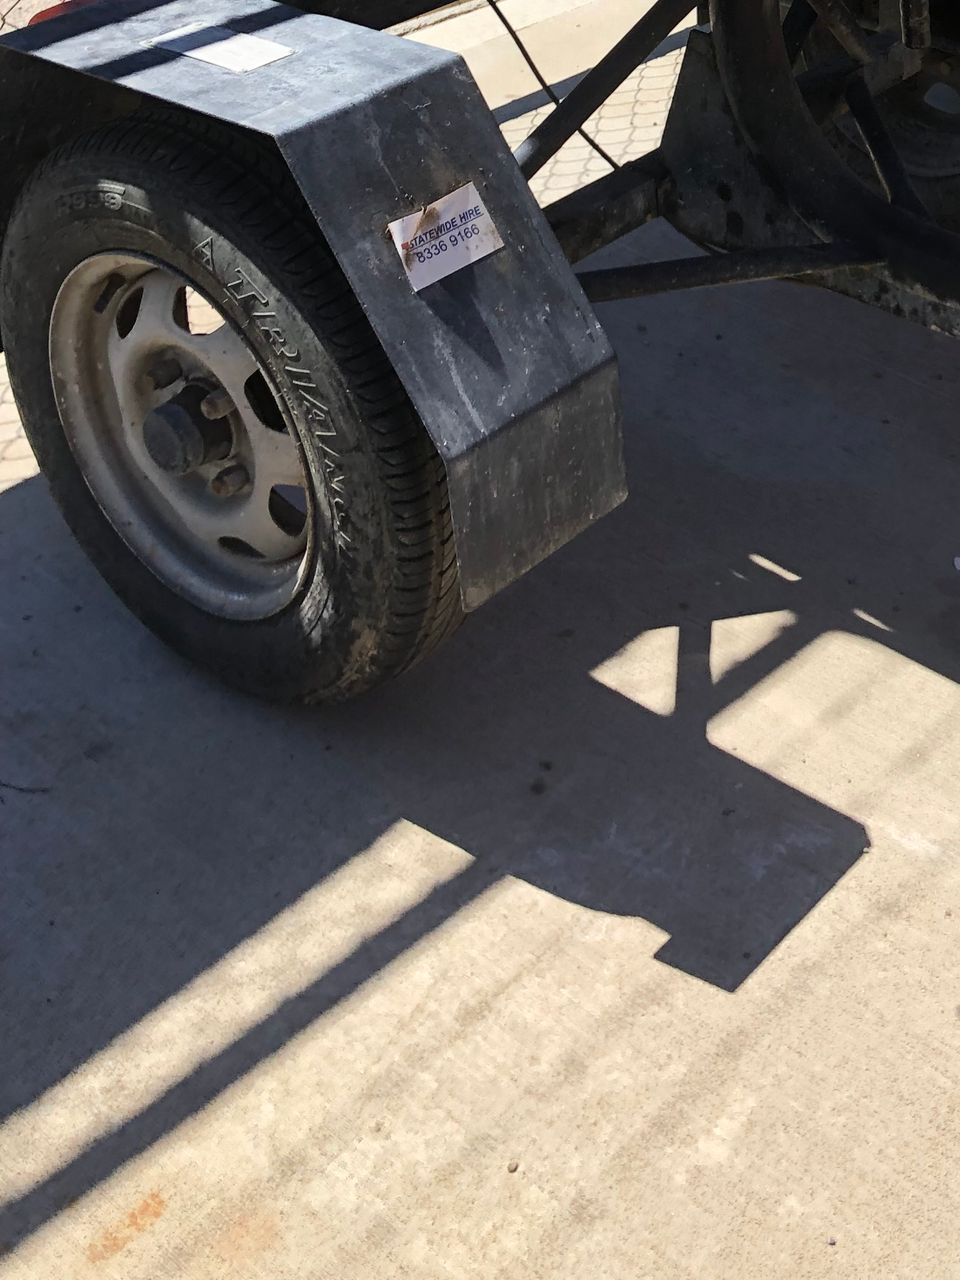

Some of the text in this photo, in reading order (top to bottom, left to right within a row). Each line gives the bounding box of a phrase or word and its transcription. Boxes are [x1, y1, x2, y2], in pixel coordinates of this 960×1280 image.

[408, 205, 481, 249] STATEWIDE HIRE
[416, 224, 479, 263] 8336 9166
